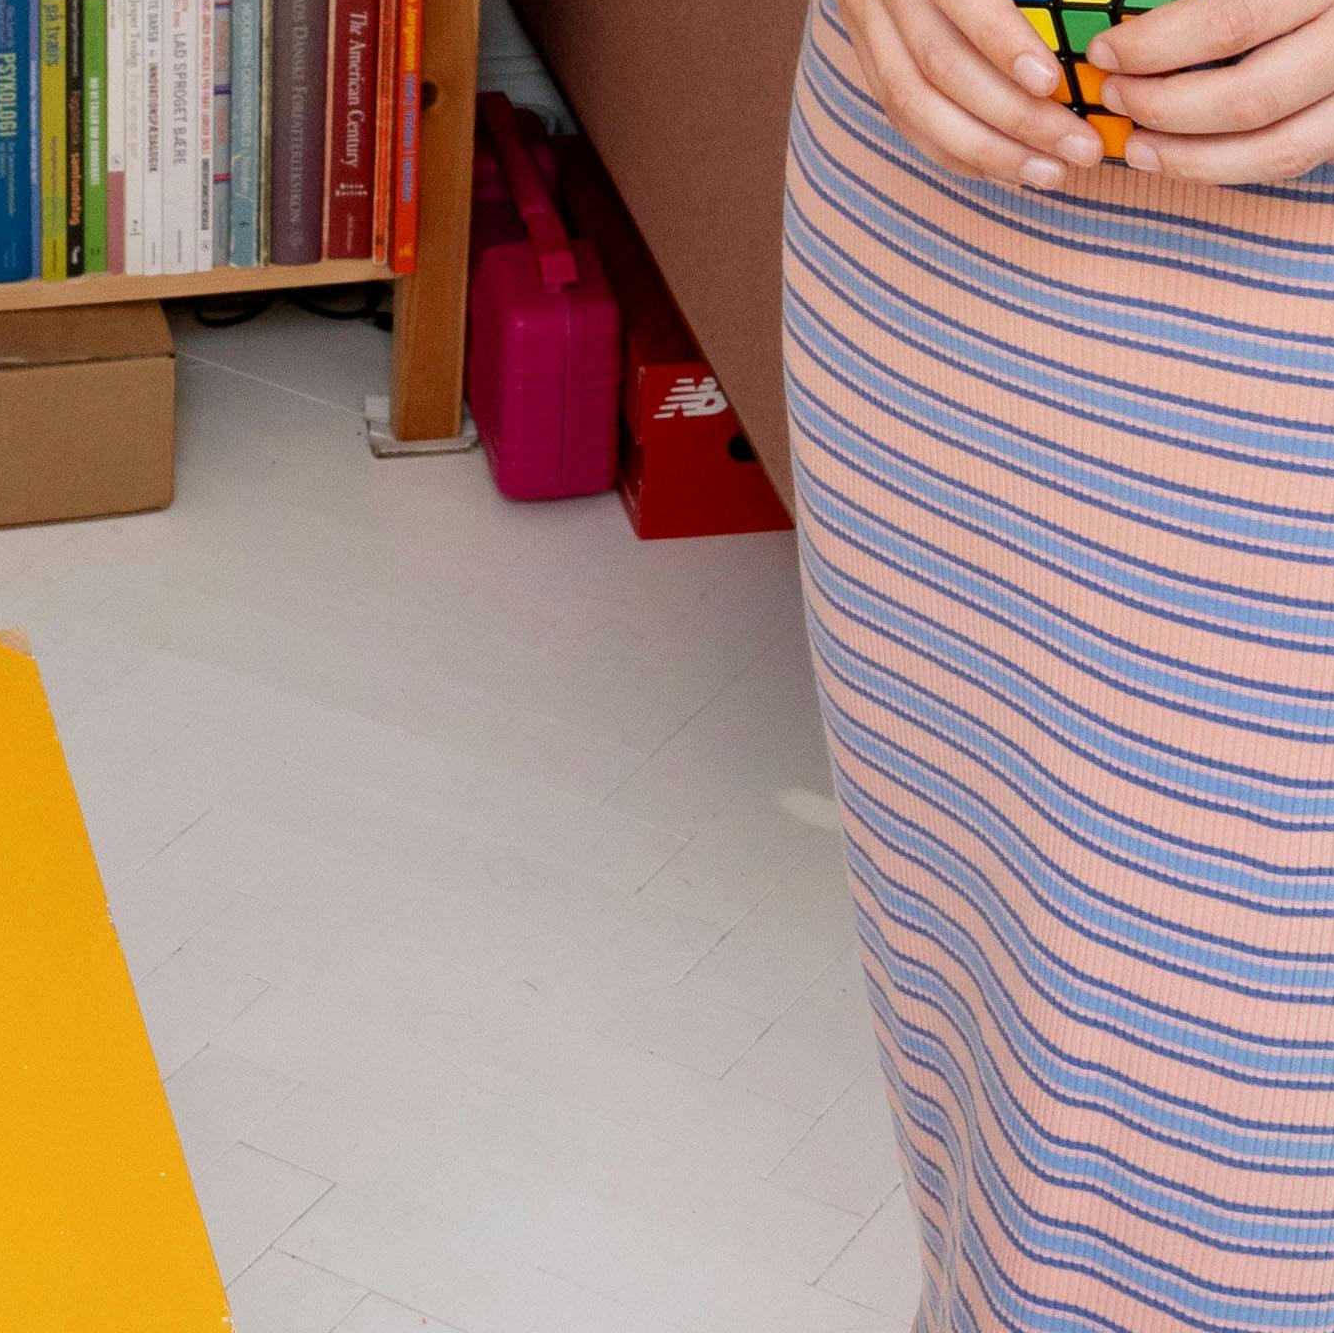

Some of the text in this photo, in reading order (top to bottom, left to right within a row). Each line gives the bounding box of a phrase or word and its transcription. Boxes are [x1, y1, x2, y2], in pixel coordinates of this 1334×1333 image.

[173, 33, 187, 58] LAD
[403, 8, 417, 71] Jørgensen
[340, 11, 369, 168] The American Century
